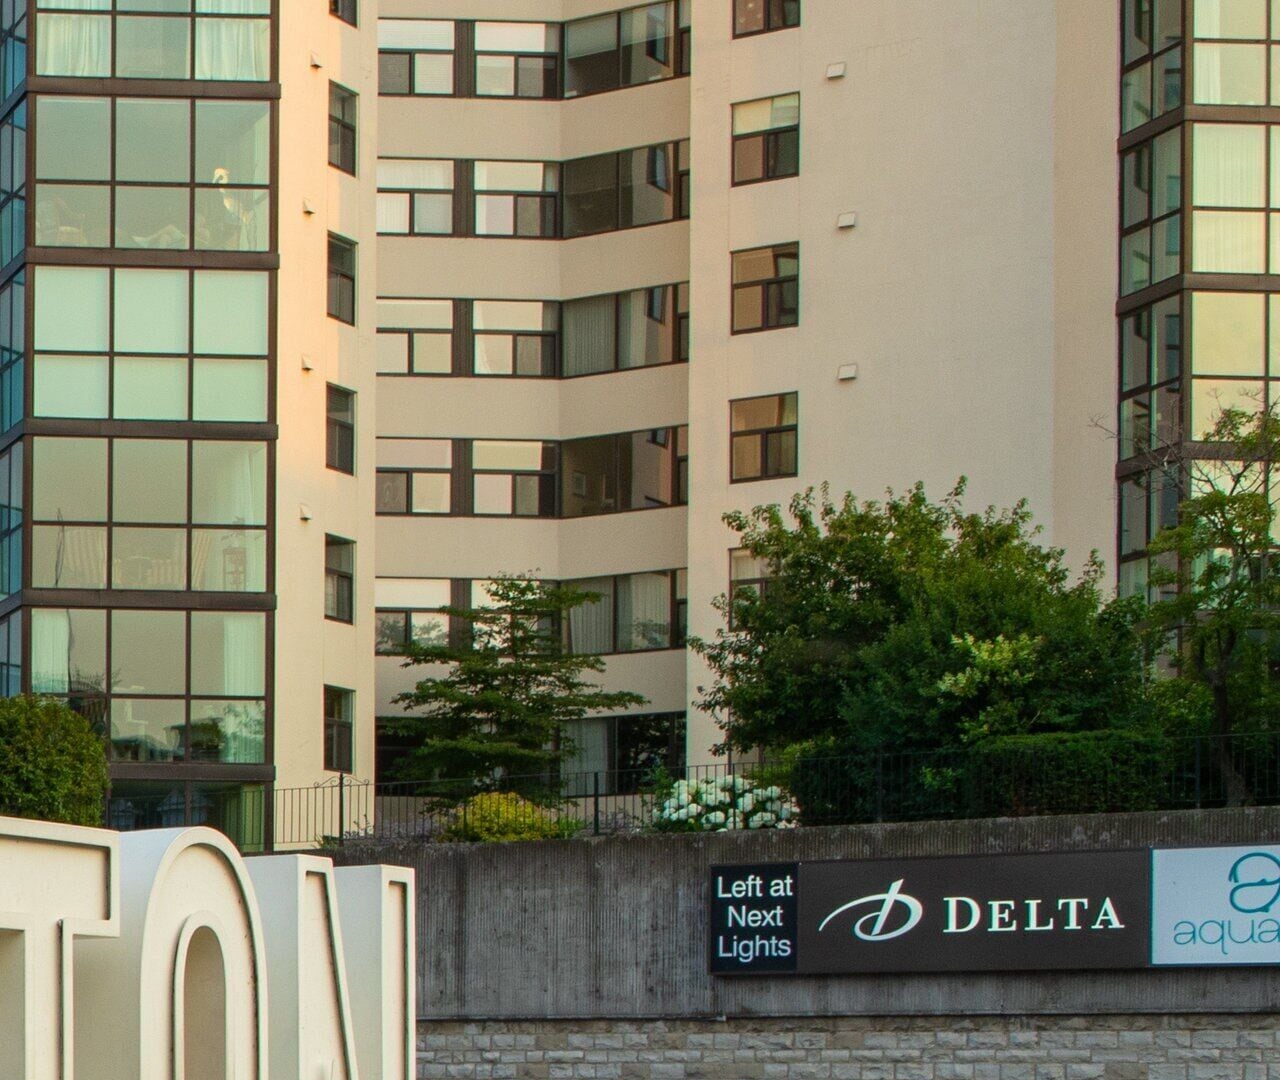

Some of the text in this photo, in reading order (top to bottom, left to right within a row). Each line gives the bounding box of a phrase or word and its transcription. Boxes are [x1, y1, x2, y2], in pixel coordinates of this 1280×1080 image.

[718, 874, 794, 898] Left at
[727, 905, 784, 928] Next
[942, 896, 1126, 933] DELTA
[718, 934, 792, 963] Lights
